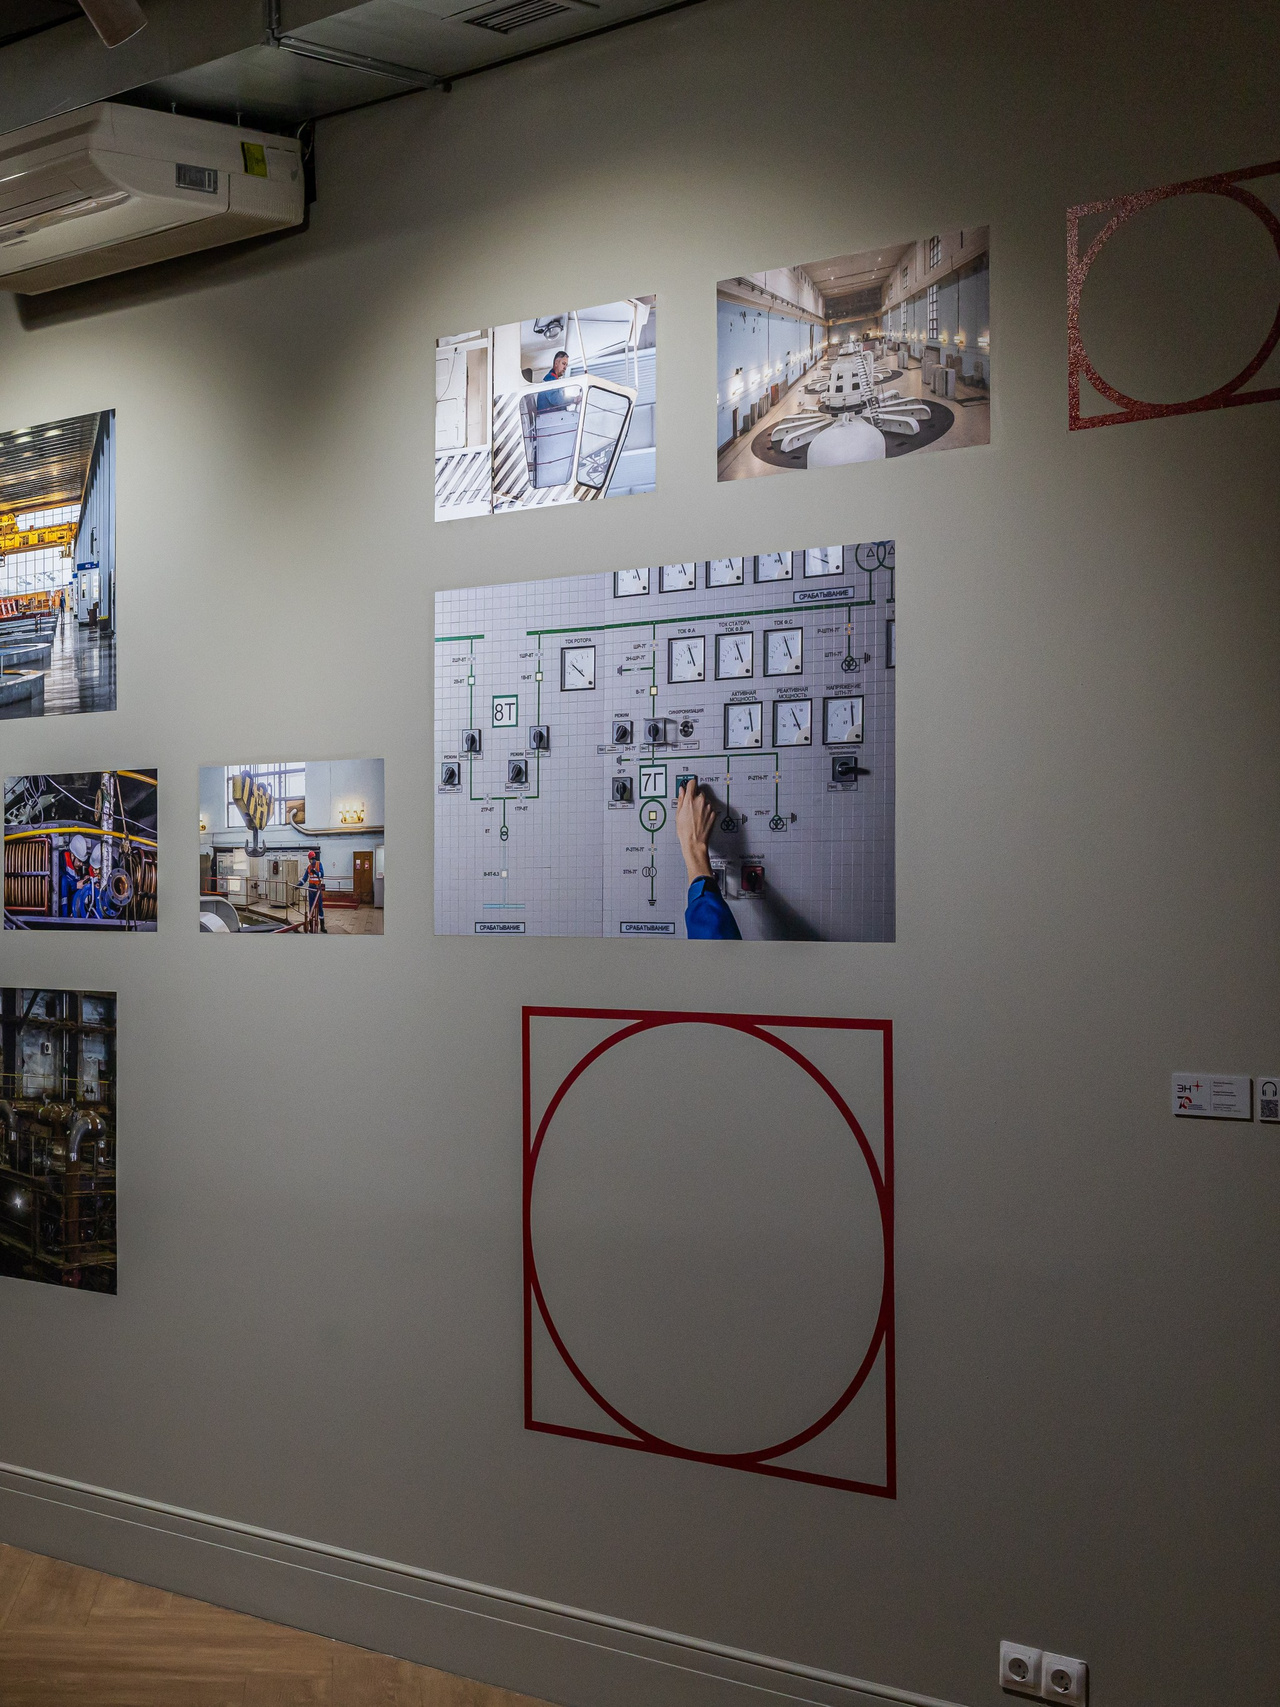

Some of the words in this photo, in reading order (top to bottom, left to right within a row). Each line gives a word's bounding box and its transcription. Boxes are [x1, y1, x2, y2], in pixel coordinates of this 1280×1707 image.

[799, 589, 849, 600] СРАБАТЫВАНИЕ
[776, 686, 809, 694] РЕАКТИВНАЯ
[494, 702, 516, 721] 8Т
[641, 772, 664, 792] 7Г
